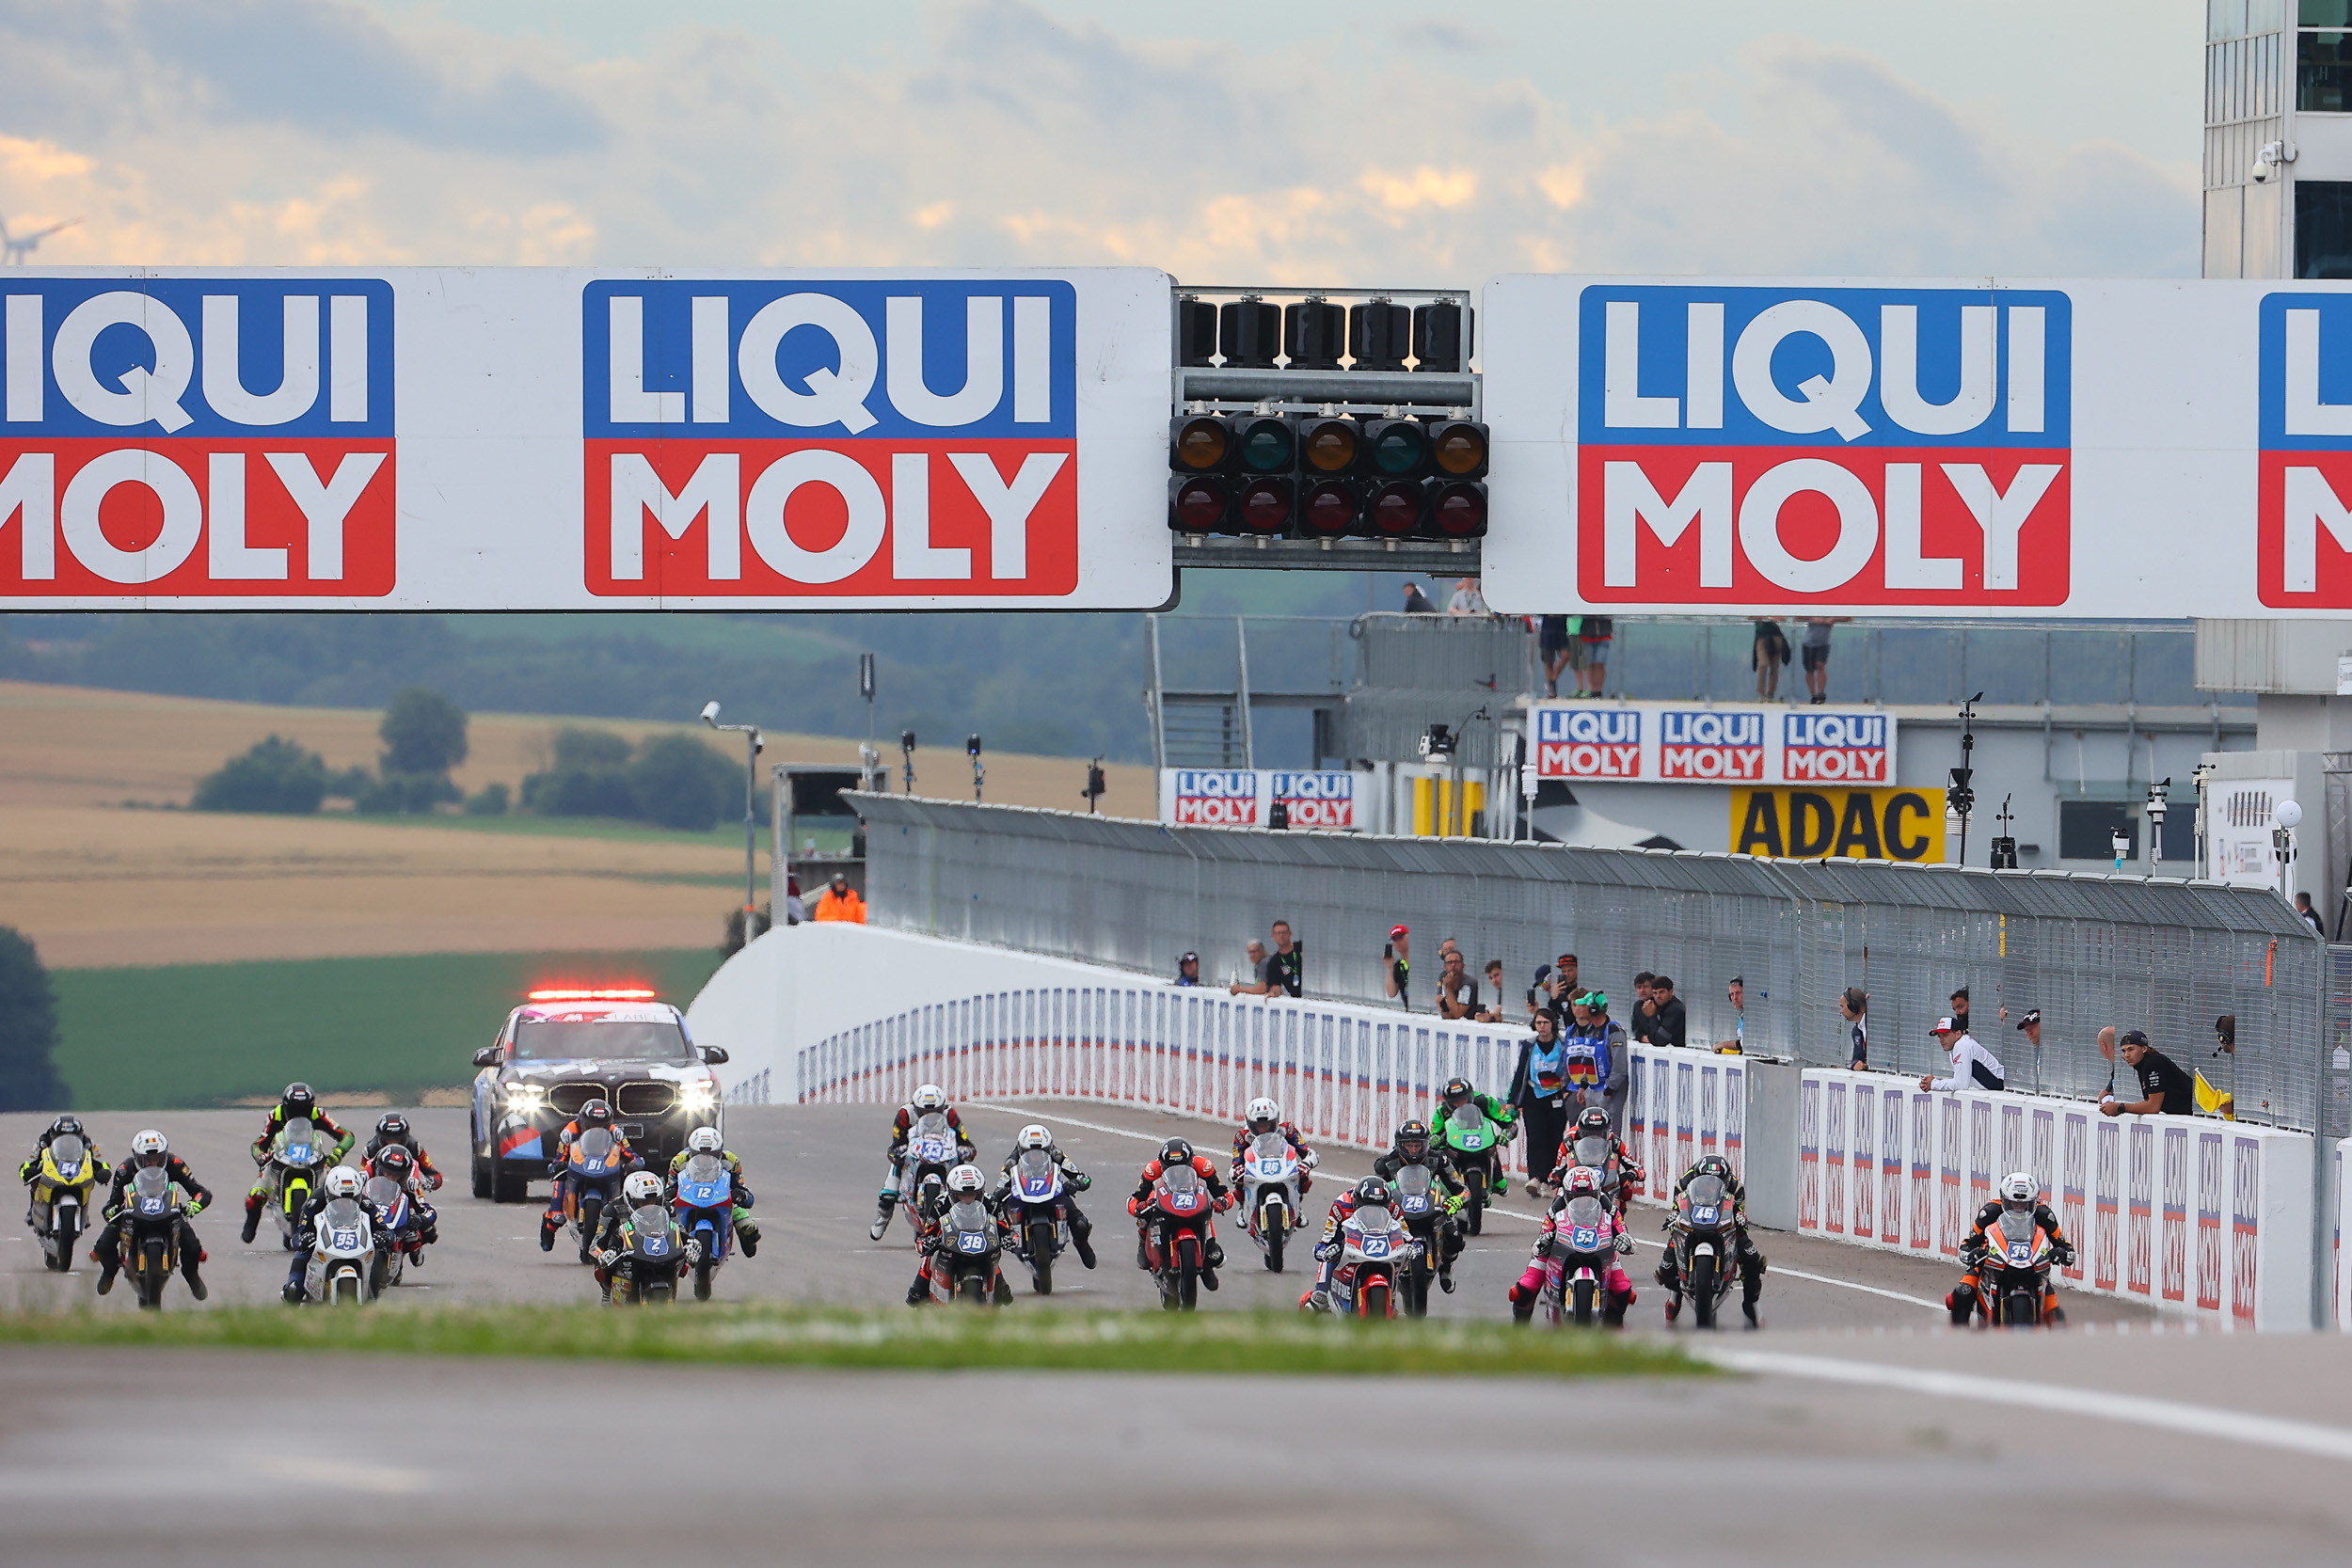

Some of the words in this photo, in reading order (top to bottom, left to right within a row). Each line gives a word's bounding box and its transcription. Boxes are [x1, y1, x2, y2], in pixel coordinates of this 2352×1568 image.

[6, 291, 369, 435] IQUI
[609, 292, 1051, 436] LIQUI
[1604, 299, 2046, 443] LIQUI
[611, 449, 1071, 584] MOLY
[1603, 458, 2064, 594] MOLY
[1542, 712, 1637, 744] LIQUI
[1542, 744, 1639, 775] MOLY
[1664, 714, 1760, 746] LIQUI
[1788, 716, 1883, 748] LIQUI
[1179, 773, 1254, 798] LIQUI
[1275, 774, 1349, 799] LIQUI
[1663, 748, 1762, 778] MOLY
[1788, 749, 1884, 779] MOLY
[1179, 799, 1255, 822] MOLY
[1739, 792, 1930, 860] ADAC
[1465, 1135, 1481, 1147] 22
[1883, 1096, 1902, 1164] LIQUI
[1912, 1101, 1931, 1168] LIQUI
[1941, 1104, 1962, 1173] LIQUI
[1971, 1108, 1991, 1178] LIQUI
[2032, 1117, 2053, 1188] LIQUI
[2065, 1120, 2086, 1192] LIQUI
[587, 1160, 603, 1171] 81
[697, 1187, 711, 1198] 12
[1030, 1179, 1045, 1191] 17
[2097, 1129, 2119, 1201] LIQUI
[2130, 1131, 2152, 1204] LIQUI
[2164, 1133, 2187, 1210] LIQUI
[2199, 1140, 2221, 1216] LIQUI
[2233, 1145, 2258, 1223] LIQUI
[143, 1198, 162, 1211] 23
[1176, 1194, 1194, 1207] 26
[1406, 1196, 1424, 1209] 28
[1694, 1208, 1714, 1220] 46
[336, 1232, 356, 1246] 95
[651, 1239, 661, 1251] 2
[962, 1237, 983, 1250] 38
[1576, 1230, 1595, 1243] 53
[2095, 1210, 2118, 1282] MOLY
[2128, 1212, 2151, 1286] MOLY
[2162, 1218, 2185, 1292] MOLY
[2197, 1225, 2220, 1303] MOLY
[2233, 1231, 2257, 1309] MOLY
